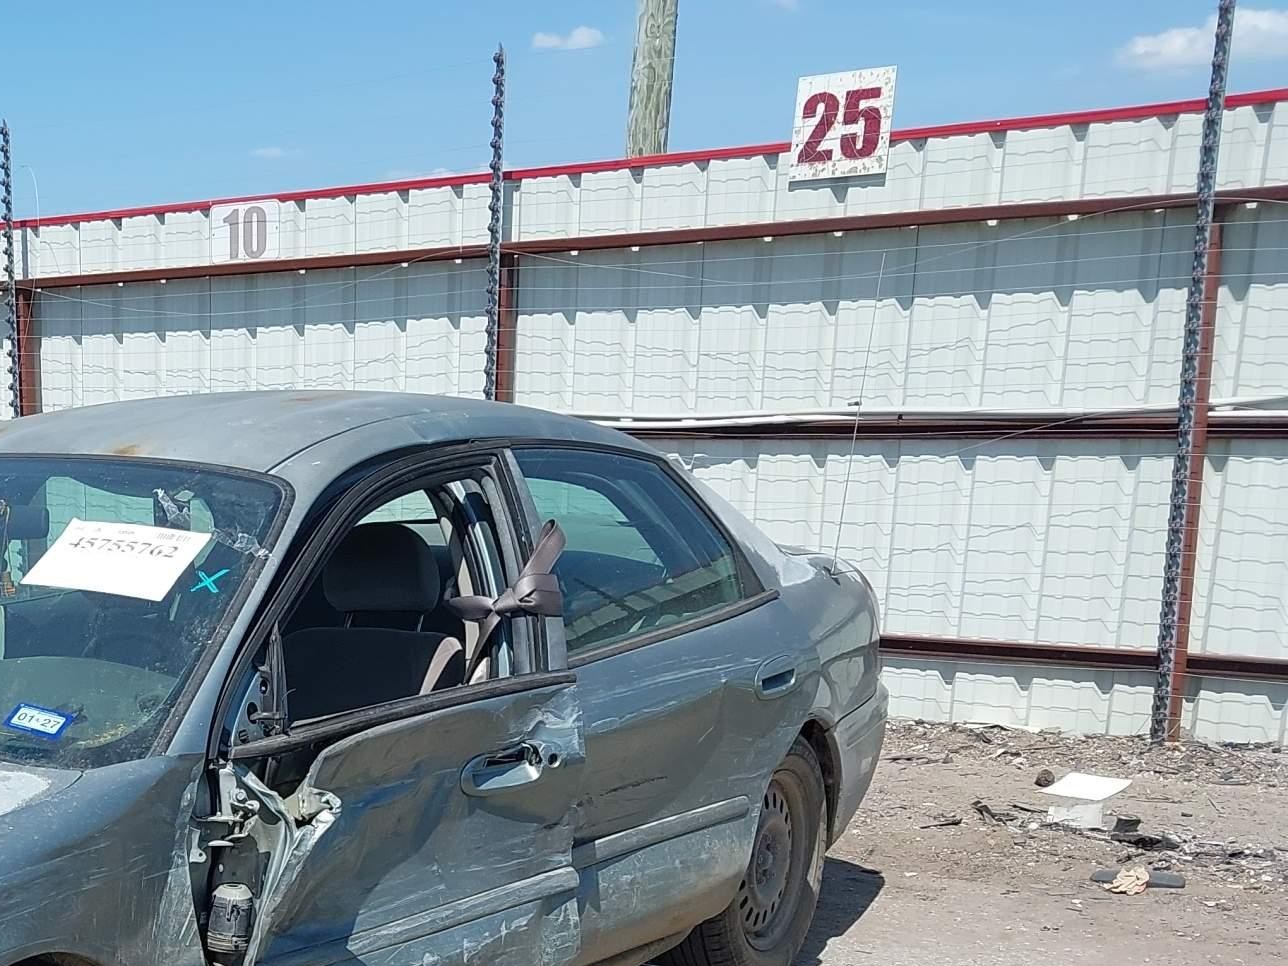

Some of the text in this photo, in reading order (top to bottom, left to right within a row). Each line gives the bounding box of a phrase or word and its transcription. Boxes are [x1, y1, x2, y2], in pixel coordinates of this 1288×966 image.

[797, 86, 882, 164] 25
[222, 205, 268, 260] 10
[68, 536, 179, 559] 45755762
